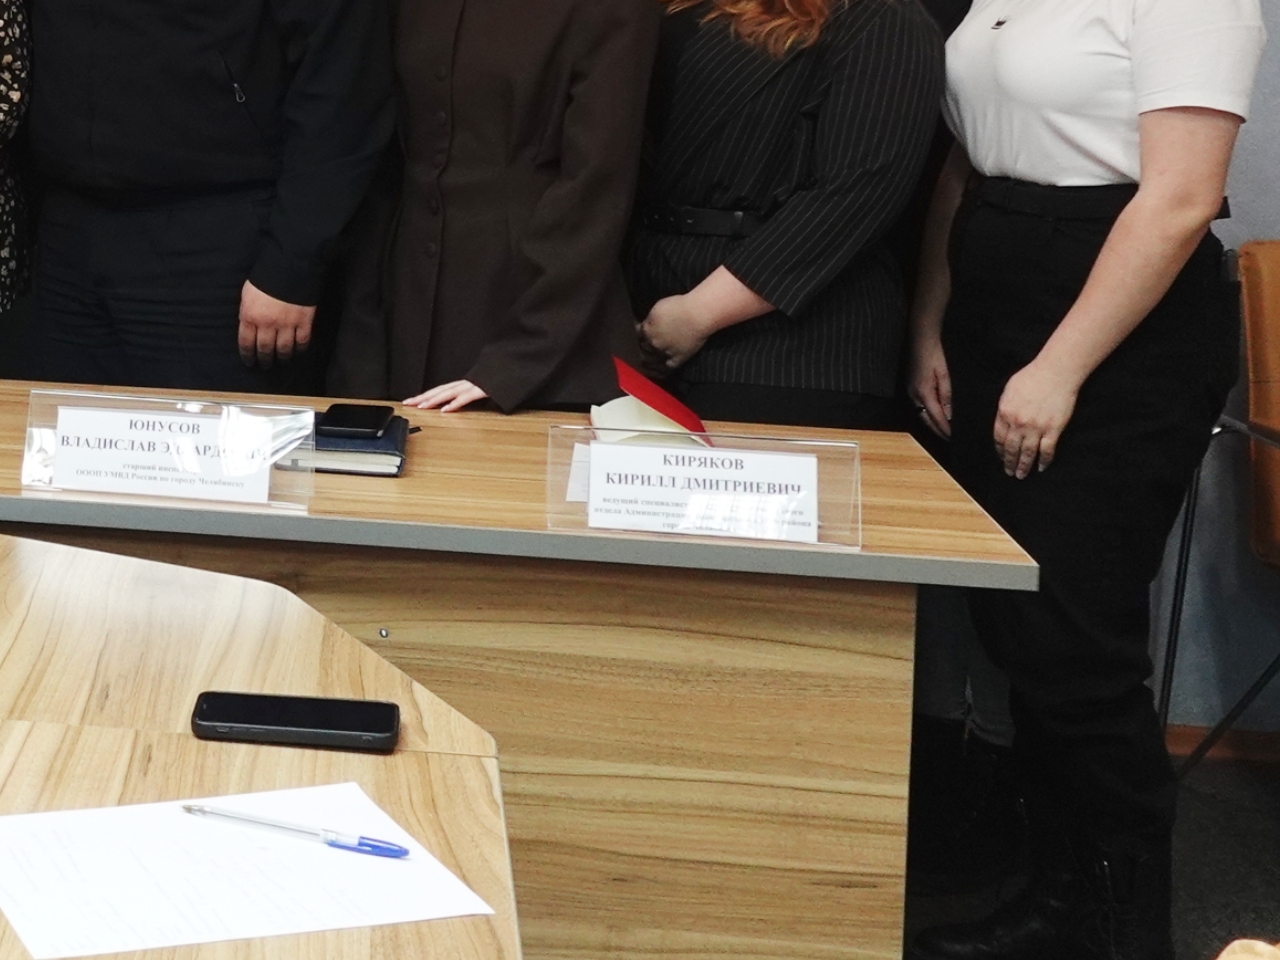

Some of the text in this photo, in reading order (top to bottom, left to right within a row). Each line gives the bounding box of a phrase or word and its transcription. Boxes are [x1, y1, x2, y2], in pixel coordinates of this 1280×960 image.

[129, 419, 201, 435] ЮНУСОВ
[60, 435, 157, 454] ВЛАДИСЛАВ
[661, 454, 745, 471] КИРЯКОВ
[102, 470, 130, 481] УМВД
[131, 472, 158, 483] России
[605, 472, 802, 496] КИРИЛЛ ДМИТРИЕВИЧ
